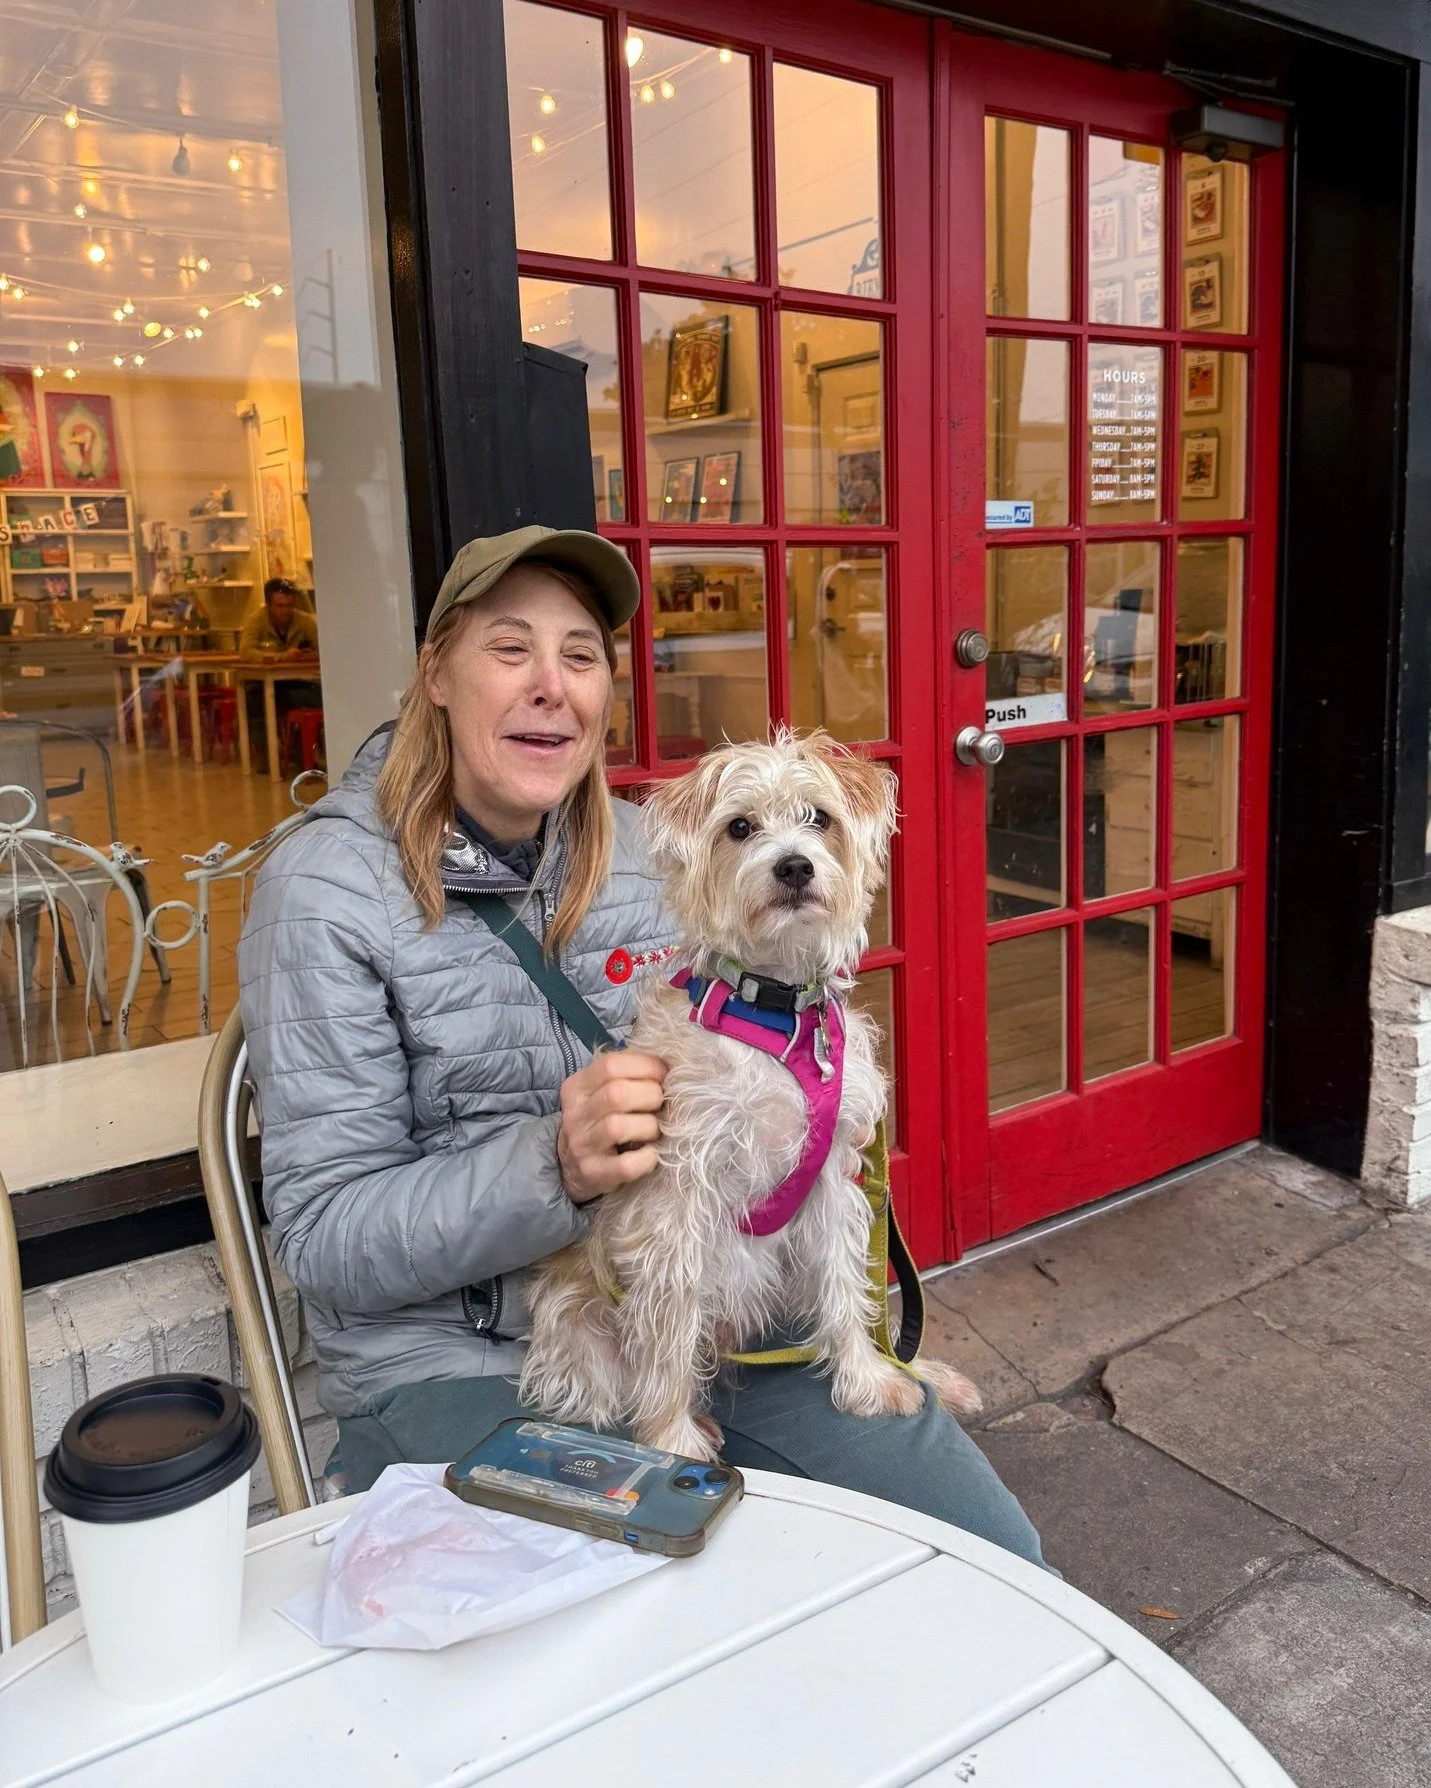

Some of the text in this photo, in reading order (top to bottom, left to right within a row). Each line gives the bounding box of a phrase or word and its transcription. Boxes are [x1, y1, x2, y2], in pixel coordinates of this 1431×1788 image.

[1103, 369, 1146, 384] HOURS
[1092, 393, 1156, 404] MONDAY 7AM-5PM
[1092, 409, 1155, 420] TUESDAY 7AM-5PM
[1092, 425, 1155, 436] WEDNESDAY 7AM-5PM
[1092, 442, 1155, 452] THURSDAY 7AM-5PM
[1092, 458, 1155, 468] FRIDAY 7AM-5PM
[1091, 474, 1155, 484] SATURDAY 8AM-5PM
[1091, 489, 1156, 500] SUNDAY 8AM-5PM
[1014, 508, 1031, 521] ADT
[985, 704, 1027, 724] Push
[575, 1460, 597, 1468] citi
[560, 1468, 598, 1478] PREFERRED
